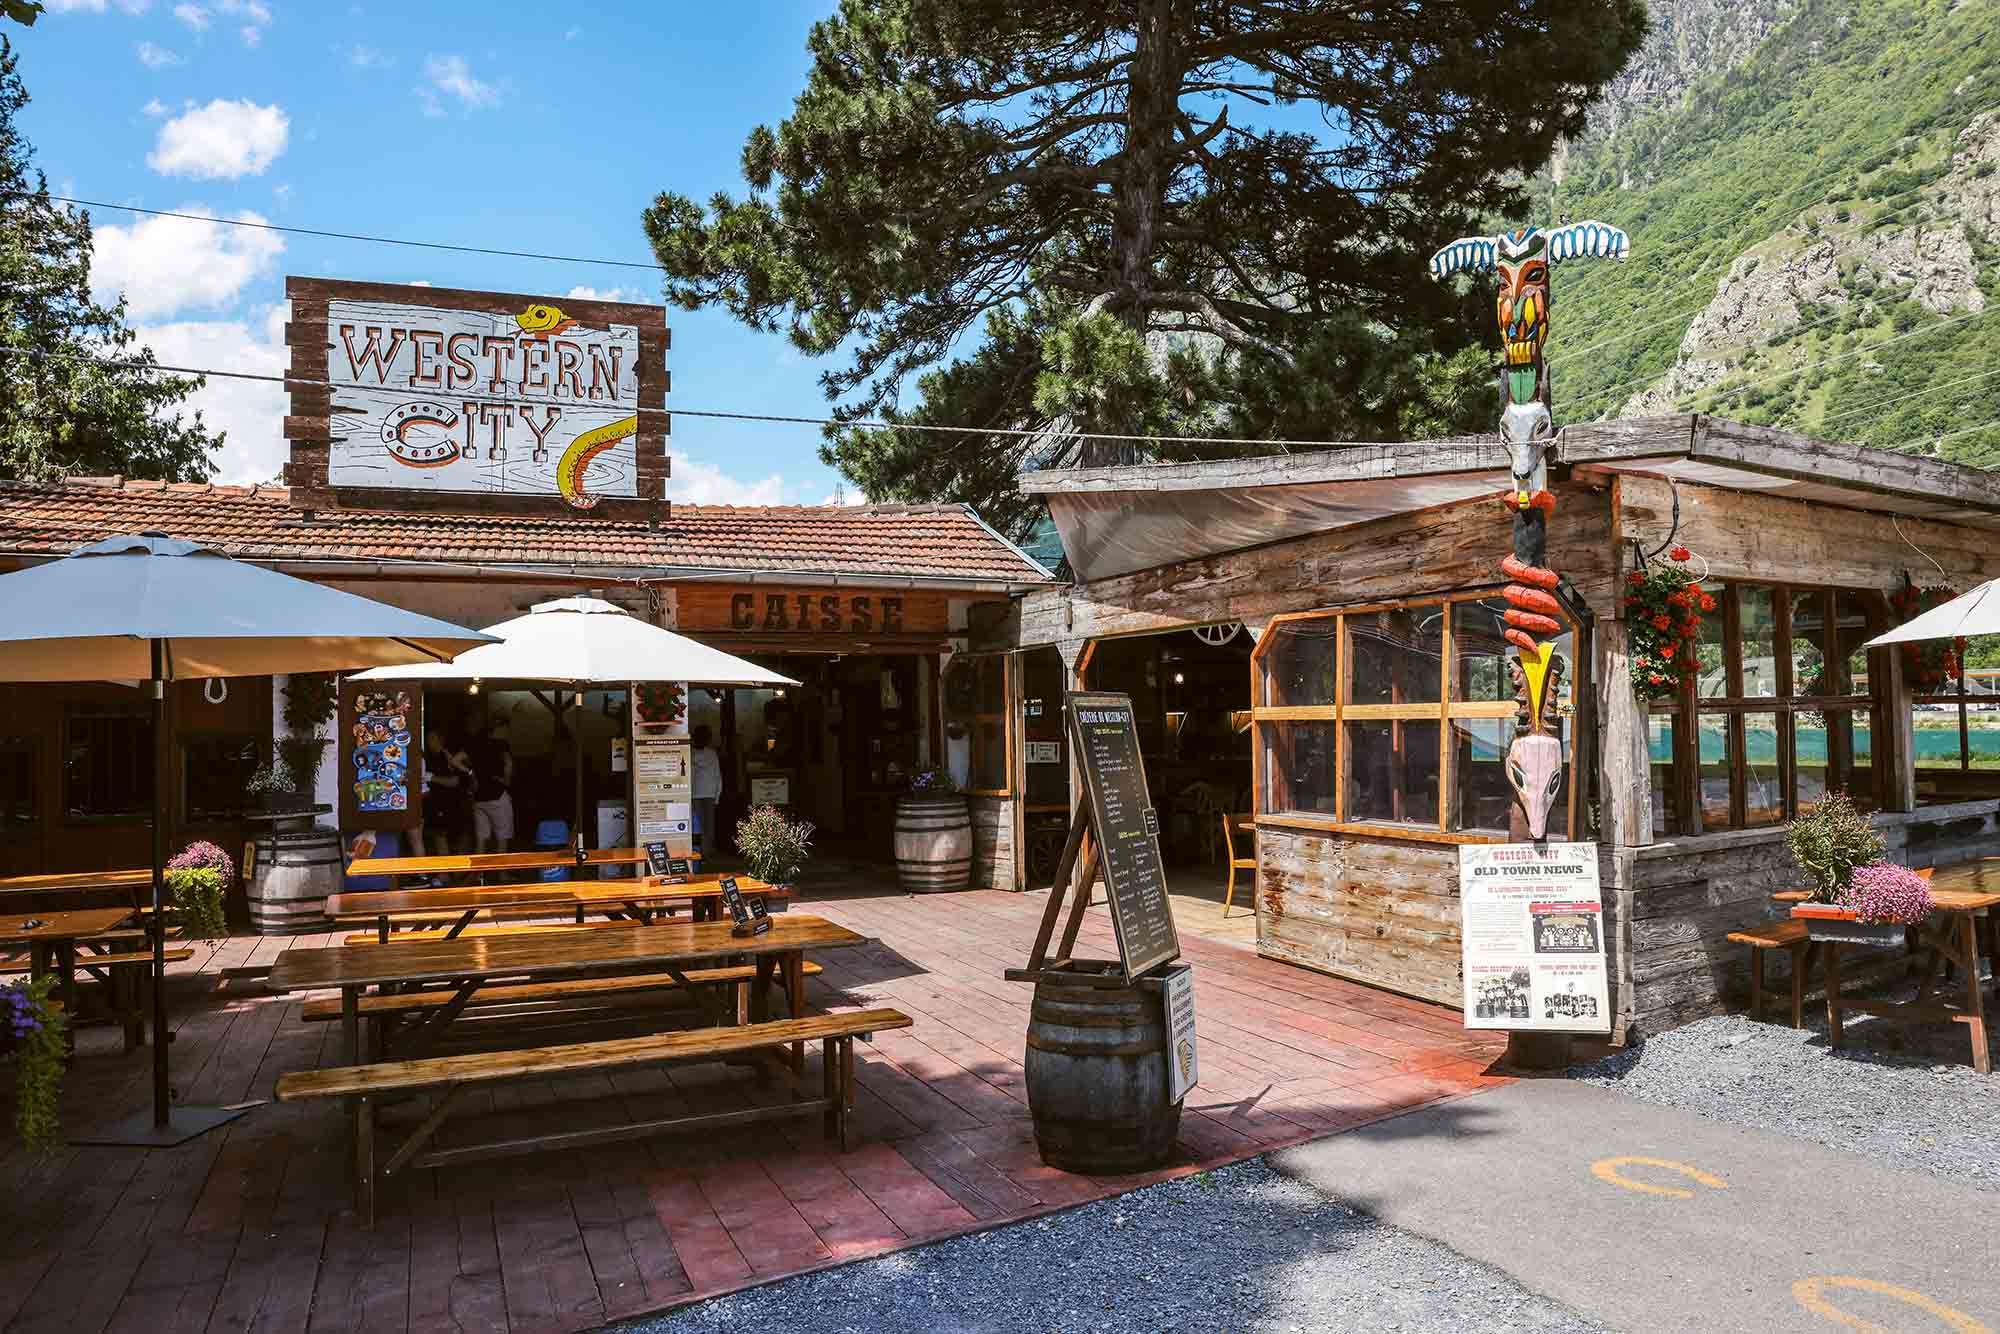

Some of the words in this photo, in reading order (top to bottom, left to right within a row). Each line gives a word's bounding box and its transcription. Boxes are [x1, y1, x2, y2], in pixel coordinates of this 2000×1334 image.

[340, 324, 623, 400] WESTERN
[380, 401, 562, 468] CITY
[731, 593, 903, 633] CAISSE
[1474, 866, 1498, 876] OLD
[1500, 865, 1541, 875] TOWN
[1544, 865, 1583, 875] NEWS
[1493, 850, 1533, 861] WESTERN
